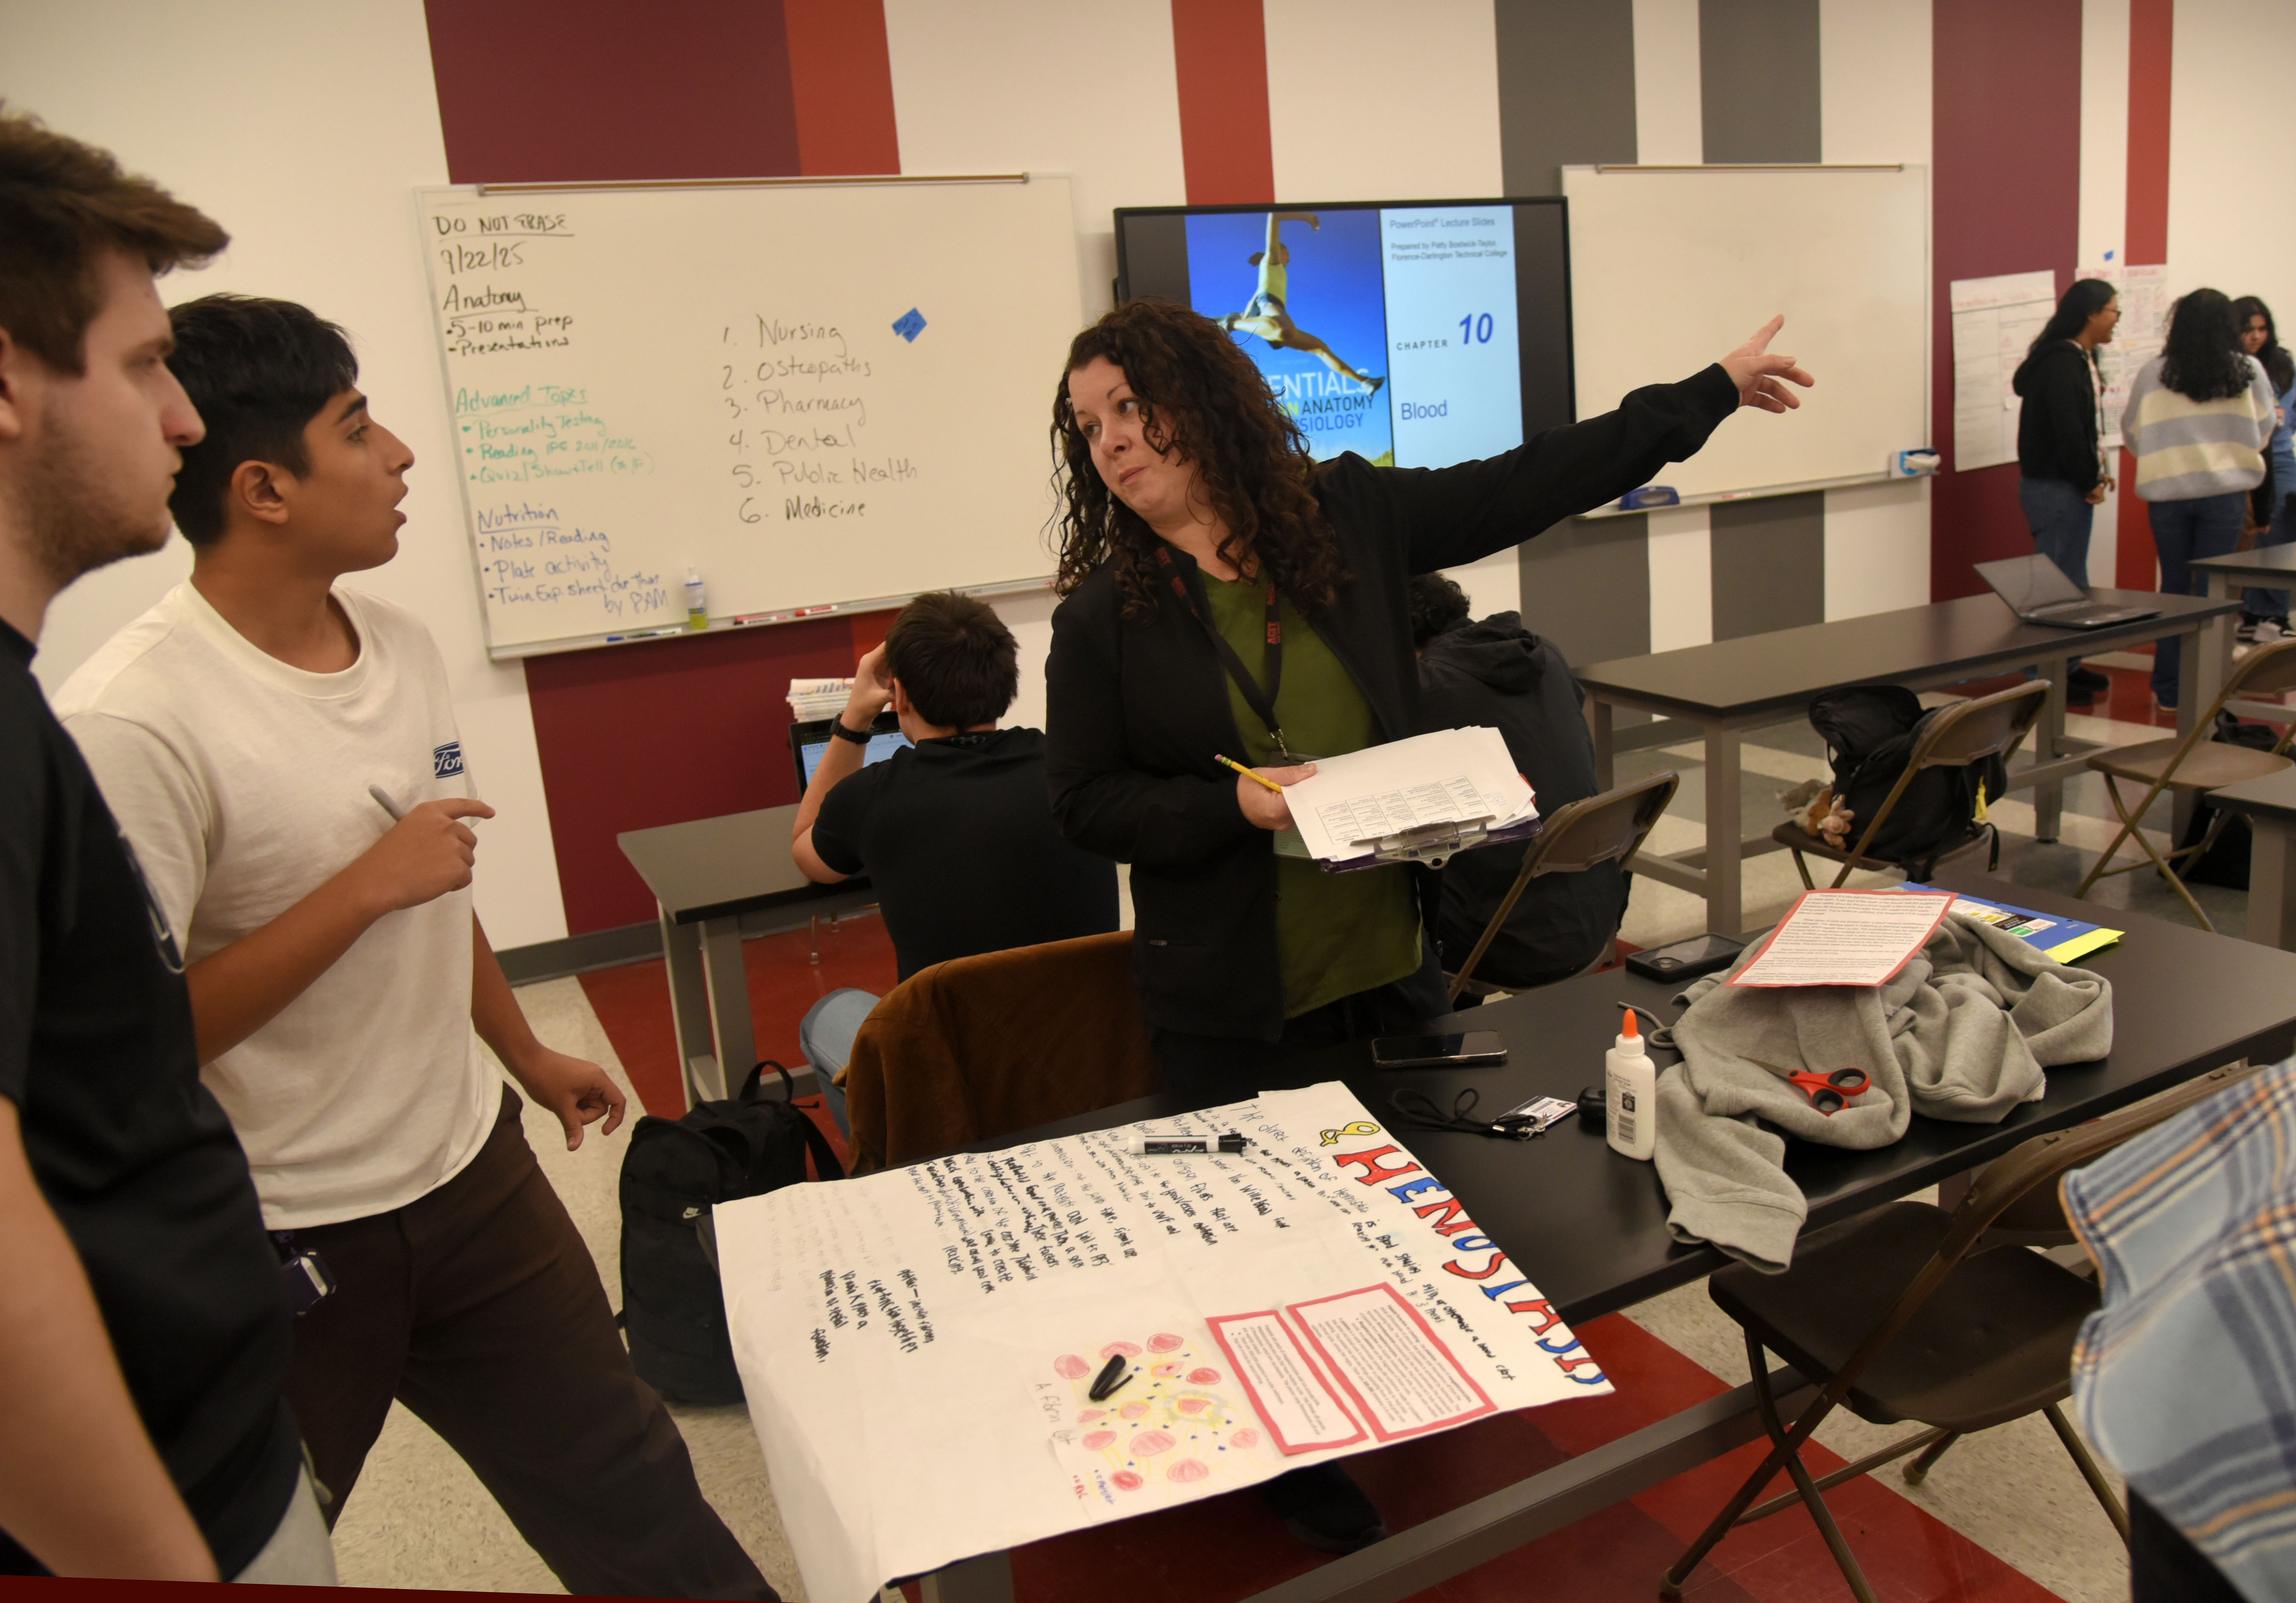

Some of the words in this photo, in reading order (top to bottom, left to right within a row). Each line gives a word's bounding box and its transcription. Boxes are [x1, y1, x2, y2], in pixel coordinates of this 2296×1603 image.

[433, 215, 467, 236] DO
[478, 215, 509, 234] NOT
[514, 213, 567, 233] ERASE
[443, 284, 527, 313] Anatomy
[535, 315, 573, 335] prep
[756, 314, 847, 358] Nursing
[1396, 339, 1448, 351] CHAPTER
[1458, 312, 1494, 345] 10
[455, 384, 530, 413] Advanced
[756, 389, 866, 427] Pharmacy
[1301, 395, 1374, 415] ANATOMY
[1401, 400, 1447, 421] Blood
[761, 424, 856, 455] Dental
[773, 460, 842, 484] Public
[852, 457, 918, 483] Health
[478, 502, 559, 530] Nutrition
[785, 495, 866, 521] Medicine
[493, 560, 535, 583] Plate
[545, 551, 611, 583] activity
[434, 747, 463, 772] For
